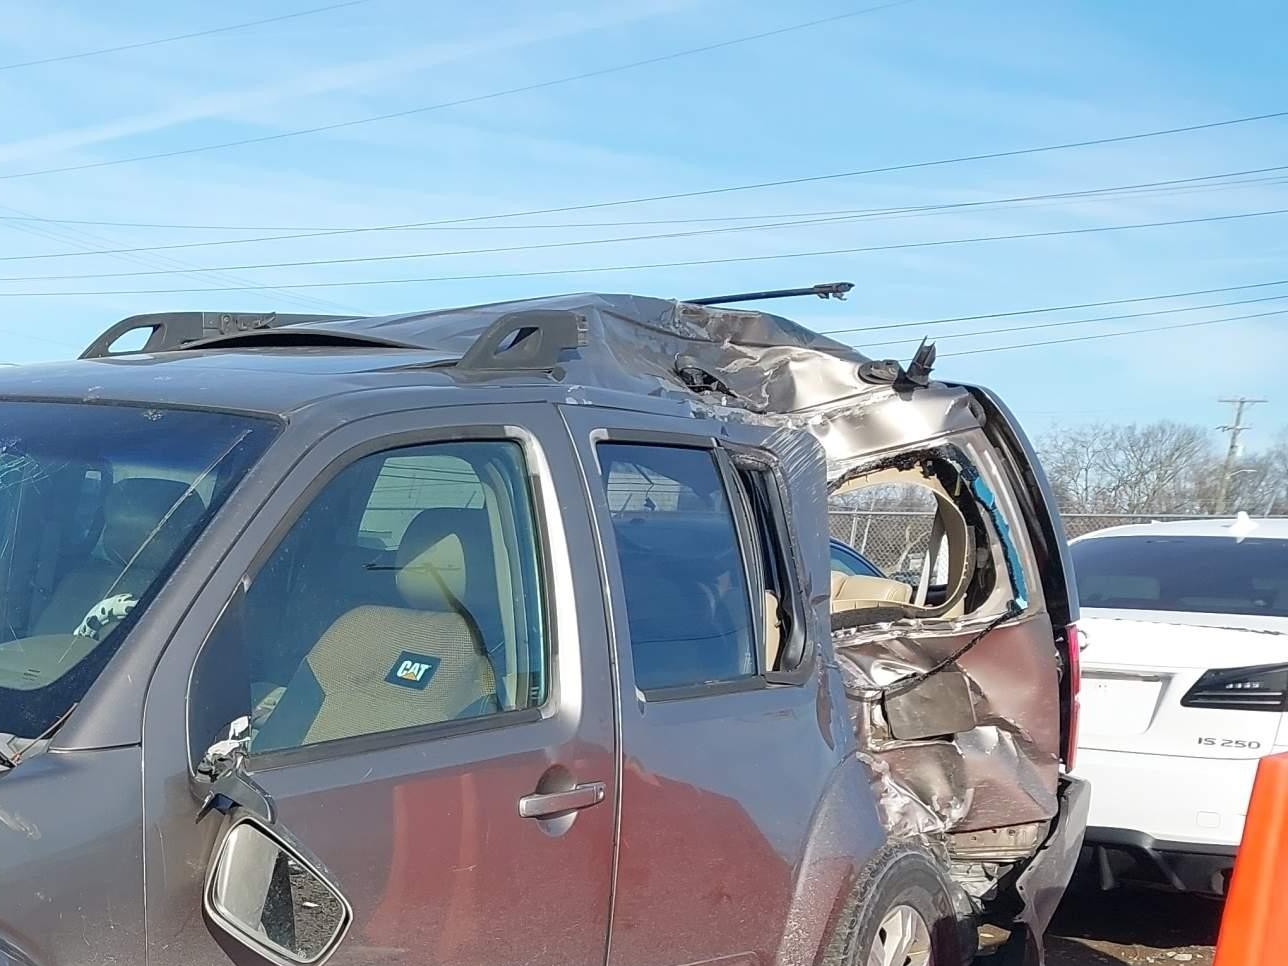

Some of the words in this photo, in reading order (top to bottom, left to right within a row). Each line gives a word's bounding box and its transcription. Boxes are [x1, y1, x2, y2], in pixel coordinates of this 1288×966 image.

[396, 660, 432, 681] CAT
[1197, 737, 1217, 746] IS
[1221, 738, 1261, 750] 250
